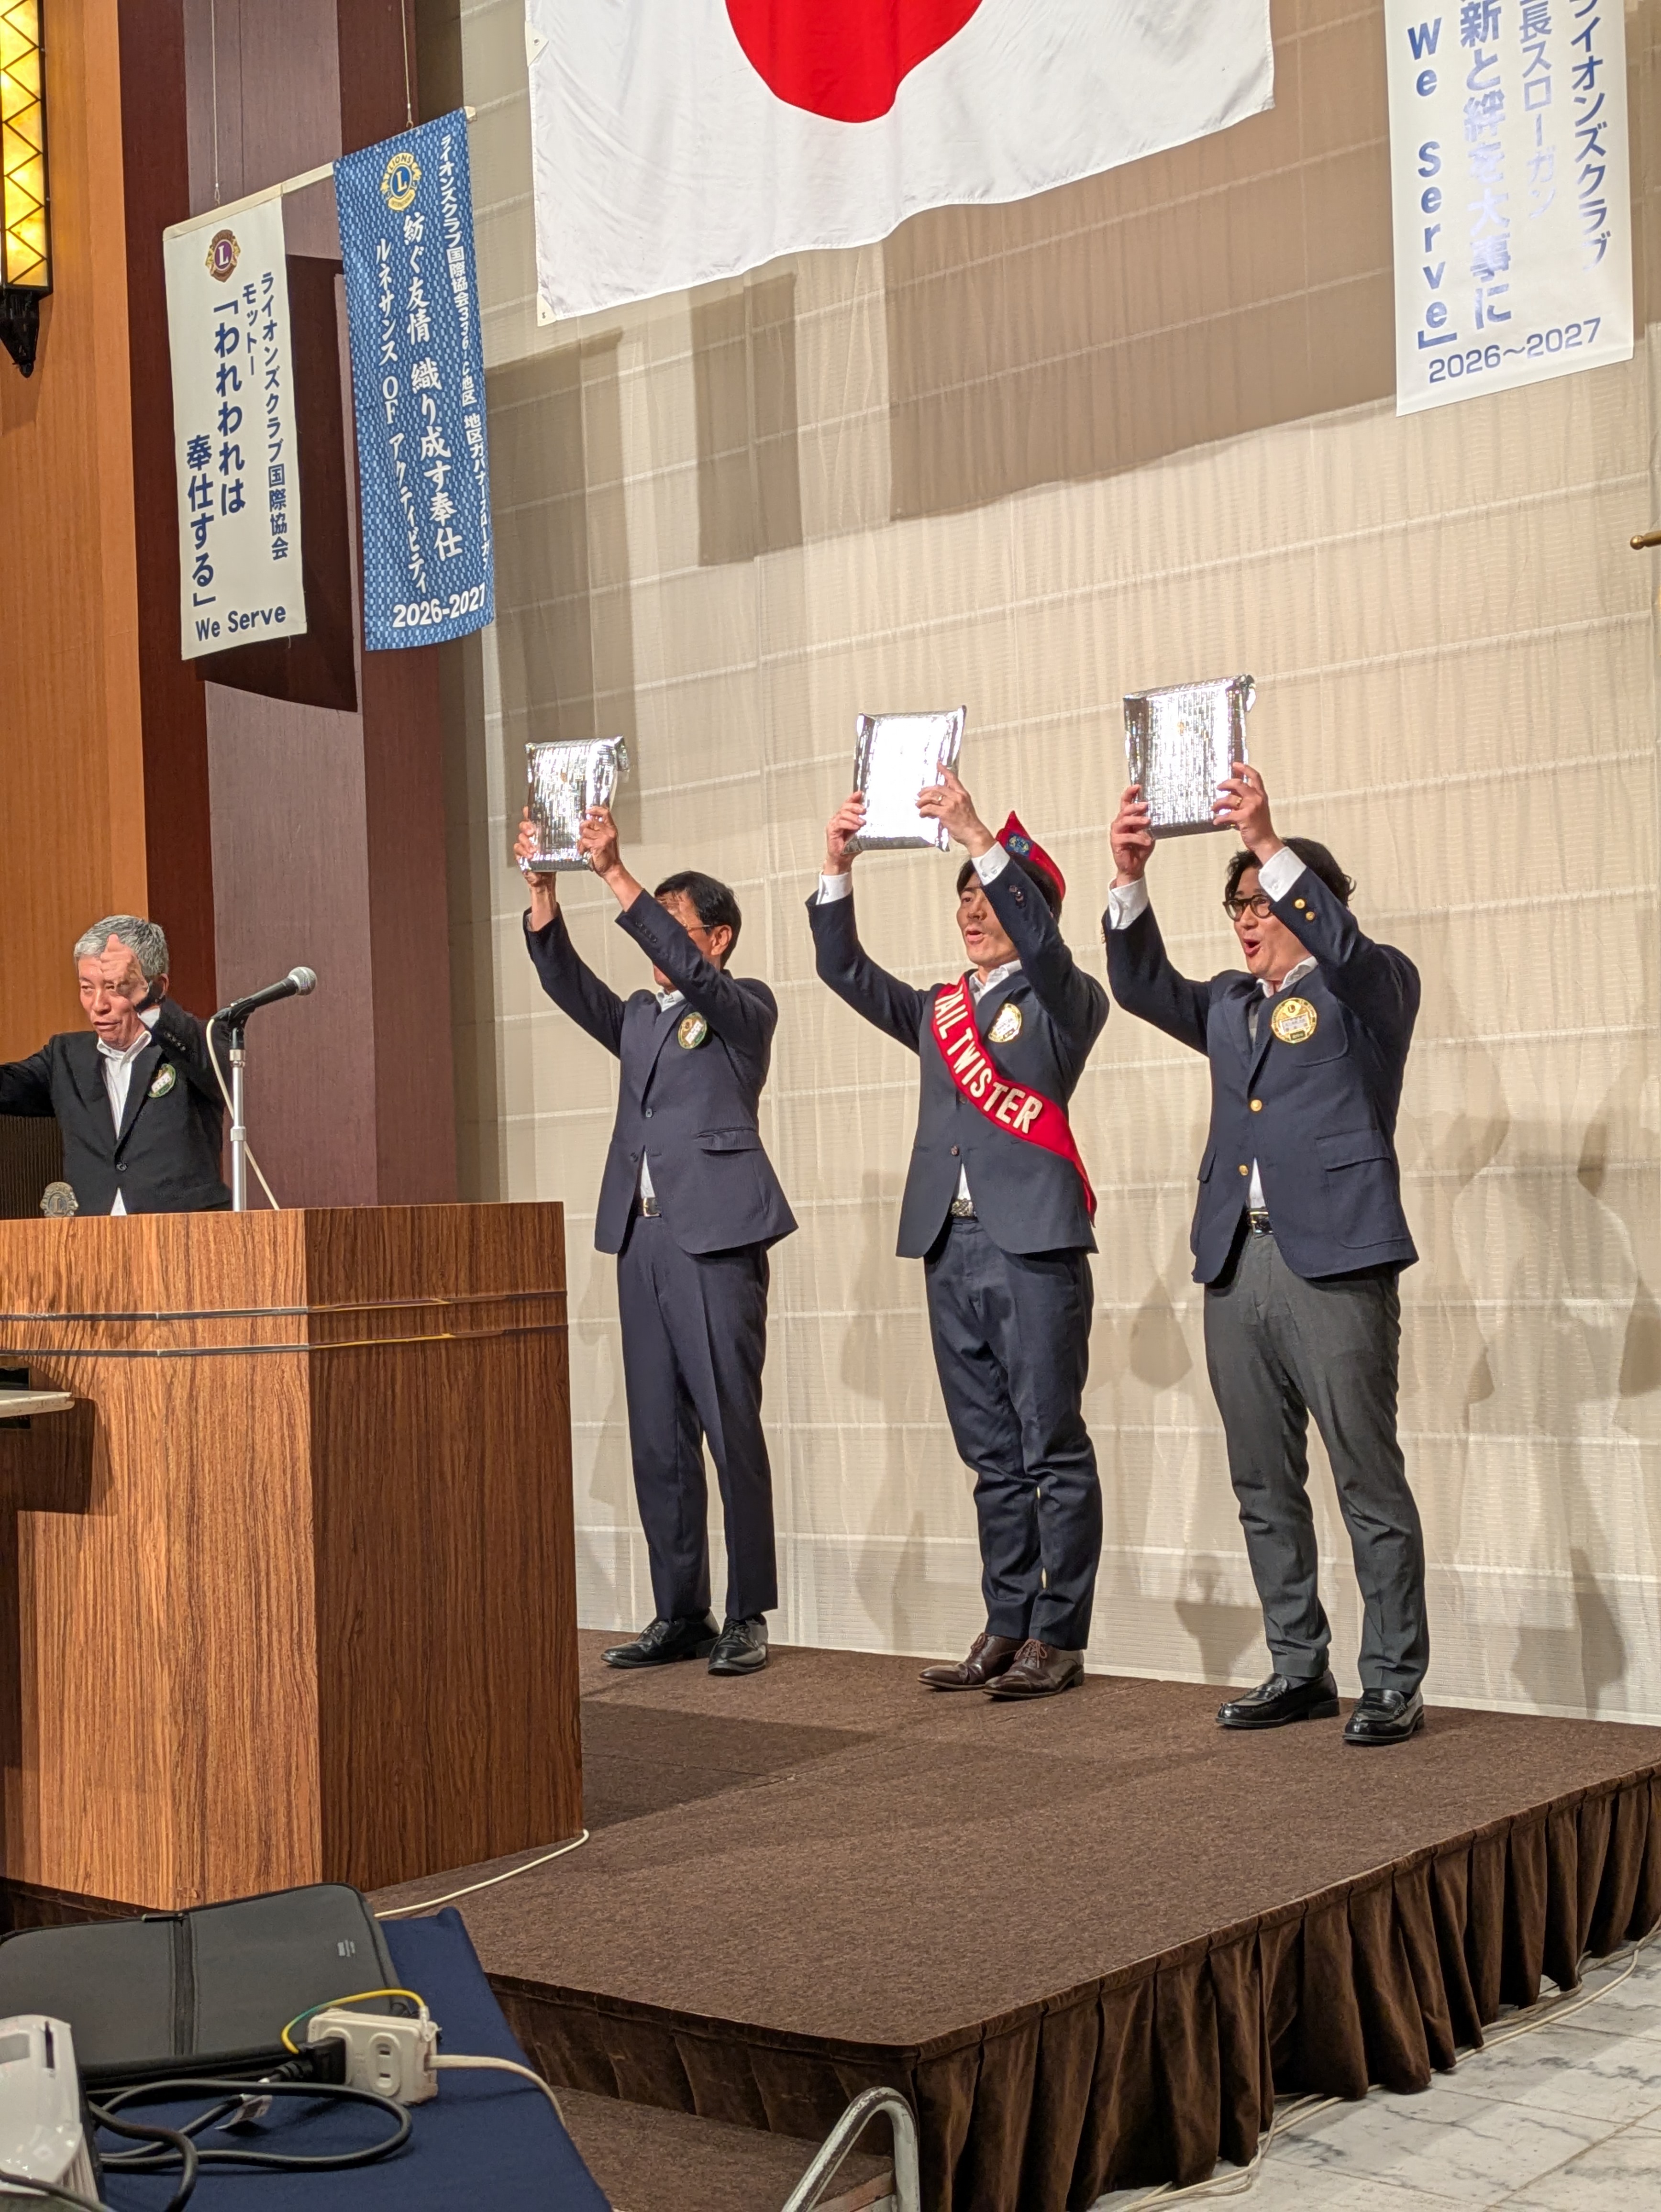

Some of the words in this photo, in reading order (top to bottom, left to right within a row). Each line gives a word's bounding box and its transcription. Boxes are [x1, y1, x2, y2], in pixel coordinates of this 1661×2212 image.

[1407, 17, 1441, 97] We
[1519, 0, 1556, 219] 長スローガン
[388, 155, 411, 170] LIONS
[396, 170, 407, 192] L
[218, 245, 229, 266] L
[376, 238, 398, 366] ルネサンス
[403, 212, 431, 345] 紡ぐ友情
[243, 283, 258, 376] モットー
[213, 299, 246, 517] 「われわれは
[261, 272, 288, 561] ライオンズクラブ国際協会
[383, 376, 398, 424] OF
[411, 357, 463, 562] 織り成す奉仕
[187, 434, 216, 607] 奉仕する」
[389, 432, 426, 594] アクティビティ
[195, 618, 220, 641] We
[228, 606, 286, 632] Serve
[392, 582, 485, 627] 2026-2027
[947, 1028, 1043, 1134] TWISTER
